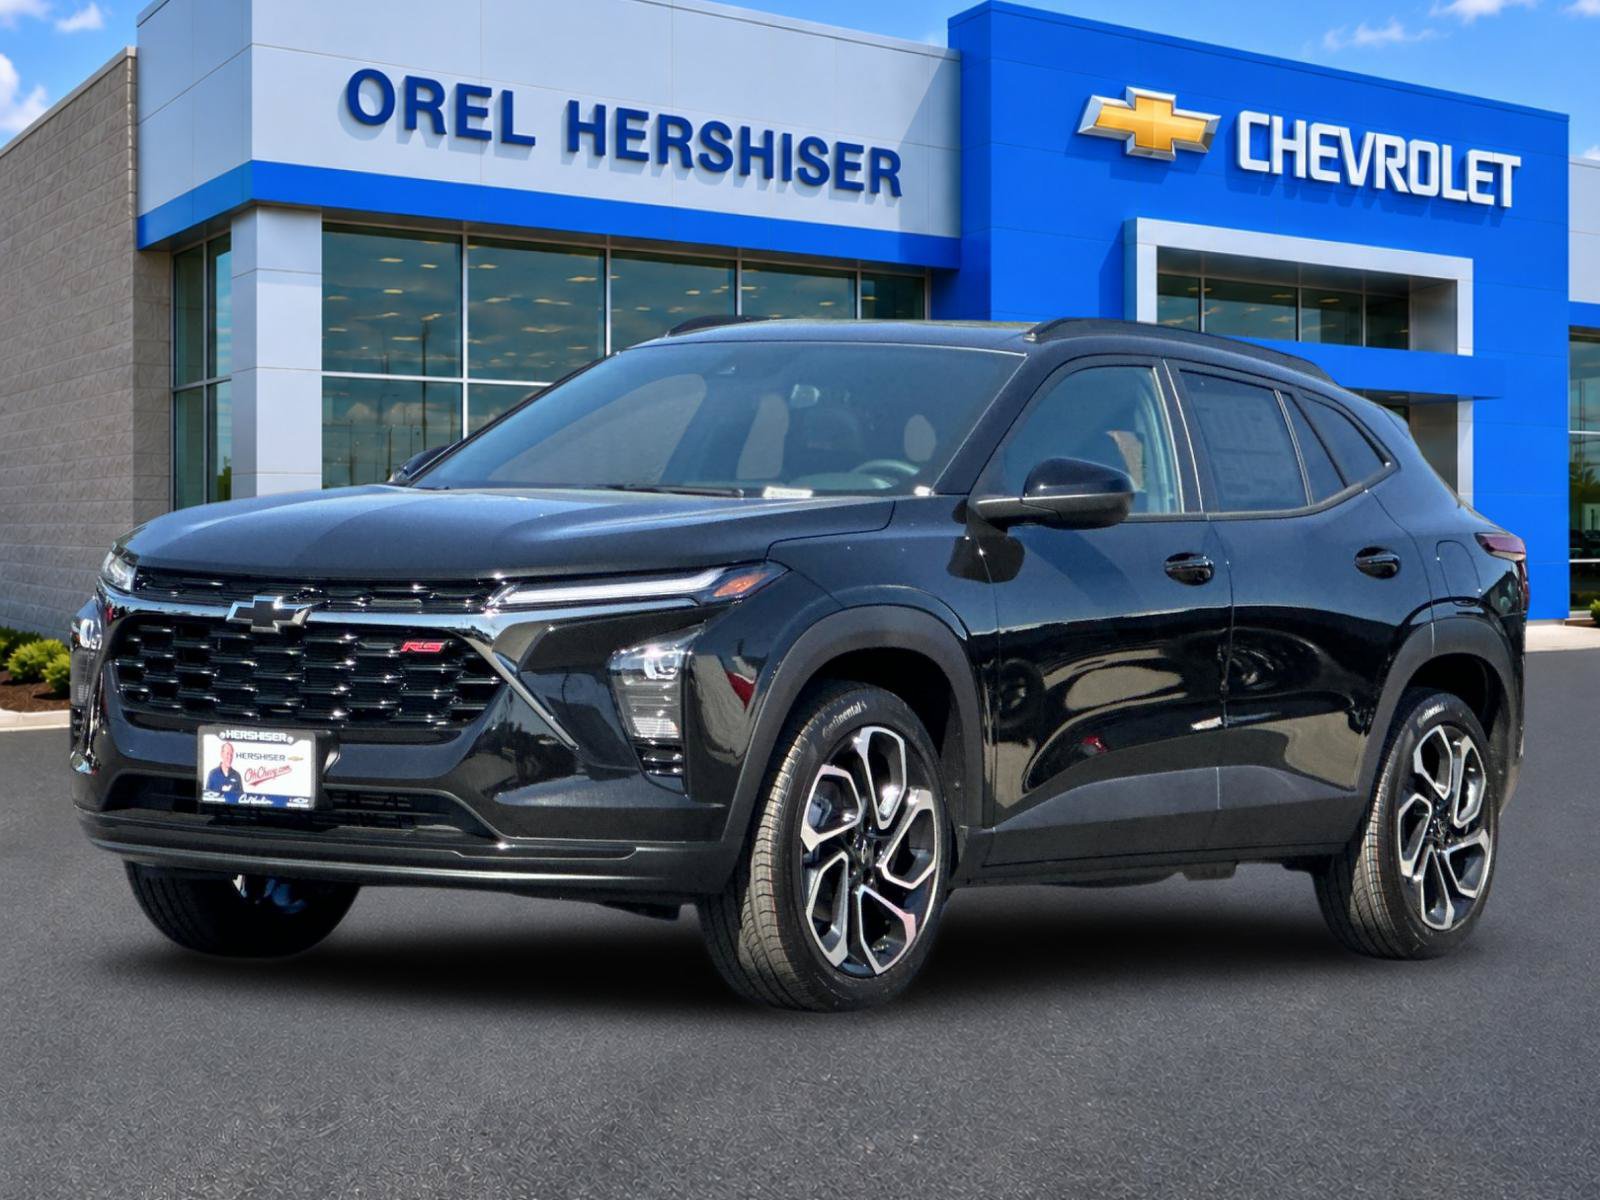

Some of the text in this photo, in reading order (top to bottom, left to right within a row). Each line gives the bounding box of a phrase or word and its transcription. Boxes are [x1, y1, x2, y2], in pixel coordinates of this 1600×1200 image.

[347, 68, 903, 197] OREL HERSHISER
[1238, 110, 1522, 208] CHEVROLET
[401, 641, 445, 652] RS
[225, 729, 287, 742] HERSHISER
[235, 752, 286, 761] HERSHISER
